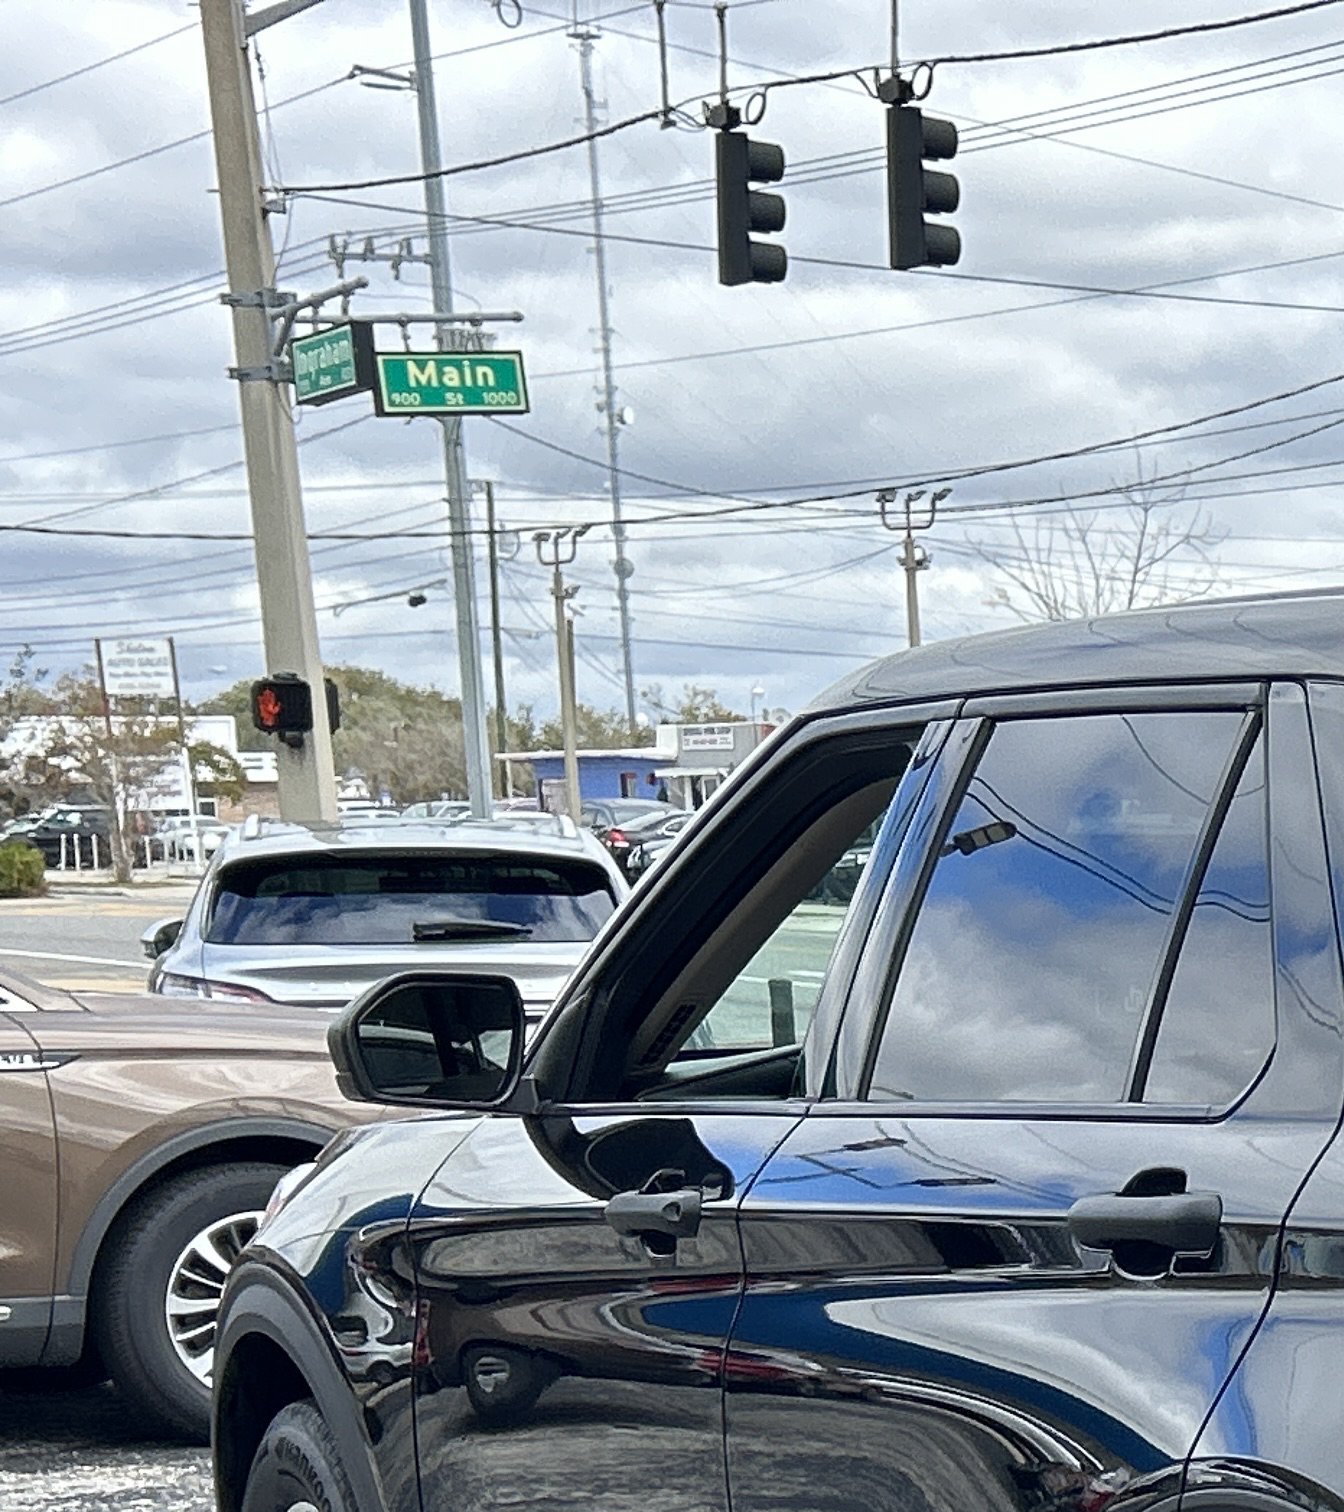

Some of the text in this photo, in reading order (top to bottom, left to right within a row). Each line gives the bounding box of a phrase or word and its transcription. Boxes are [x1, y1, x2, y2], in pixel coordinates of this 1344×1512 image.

[406, 360, 496, 388] Main
[390, 391, 517, 405] 900 St 1000
